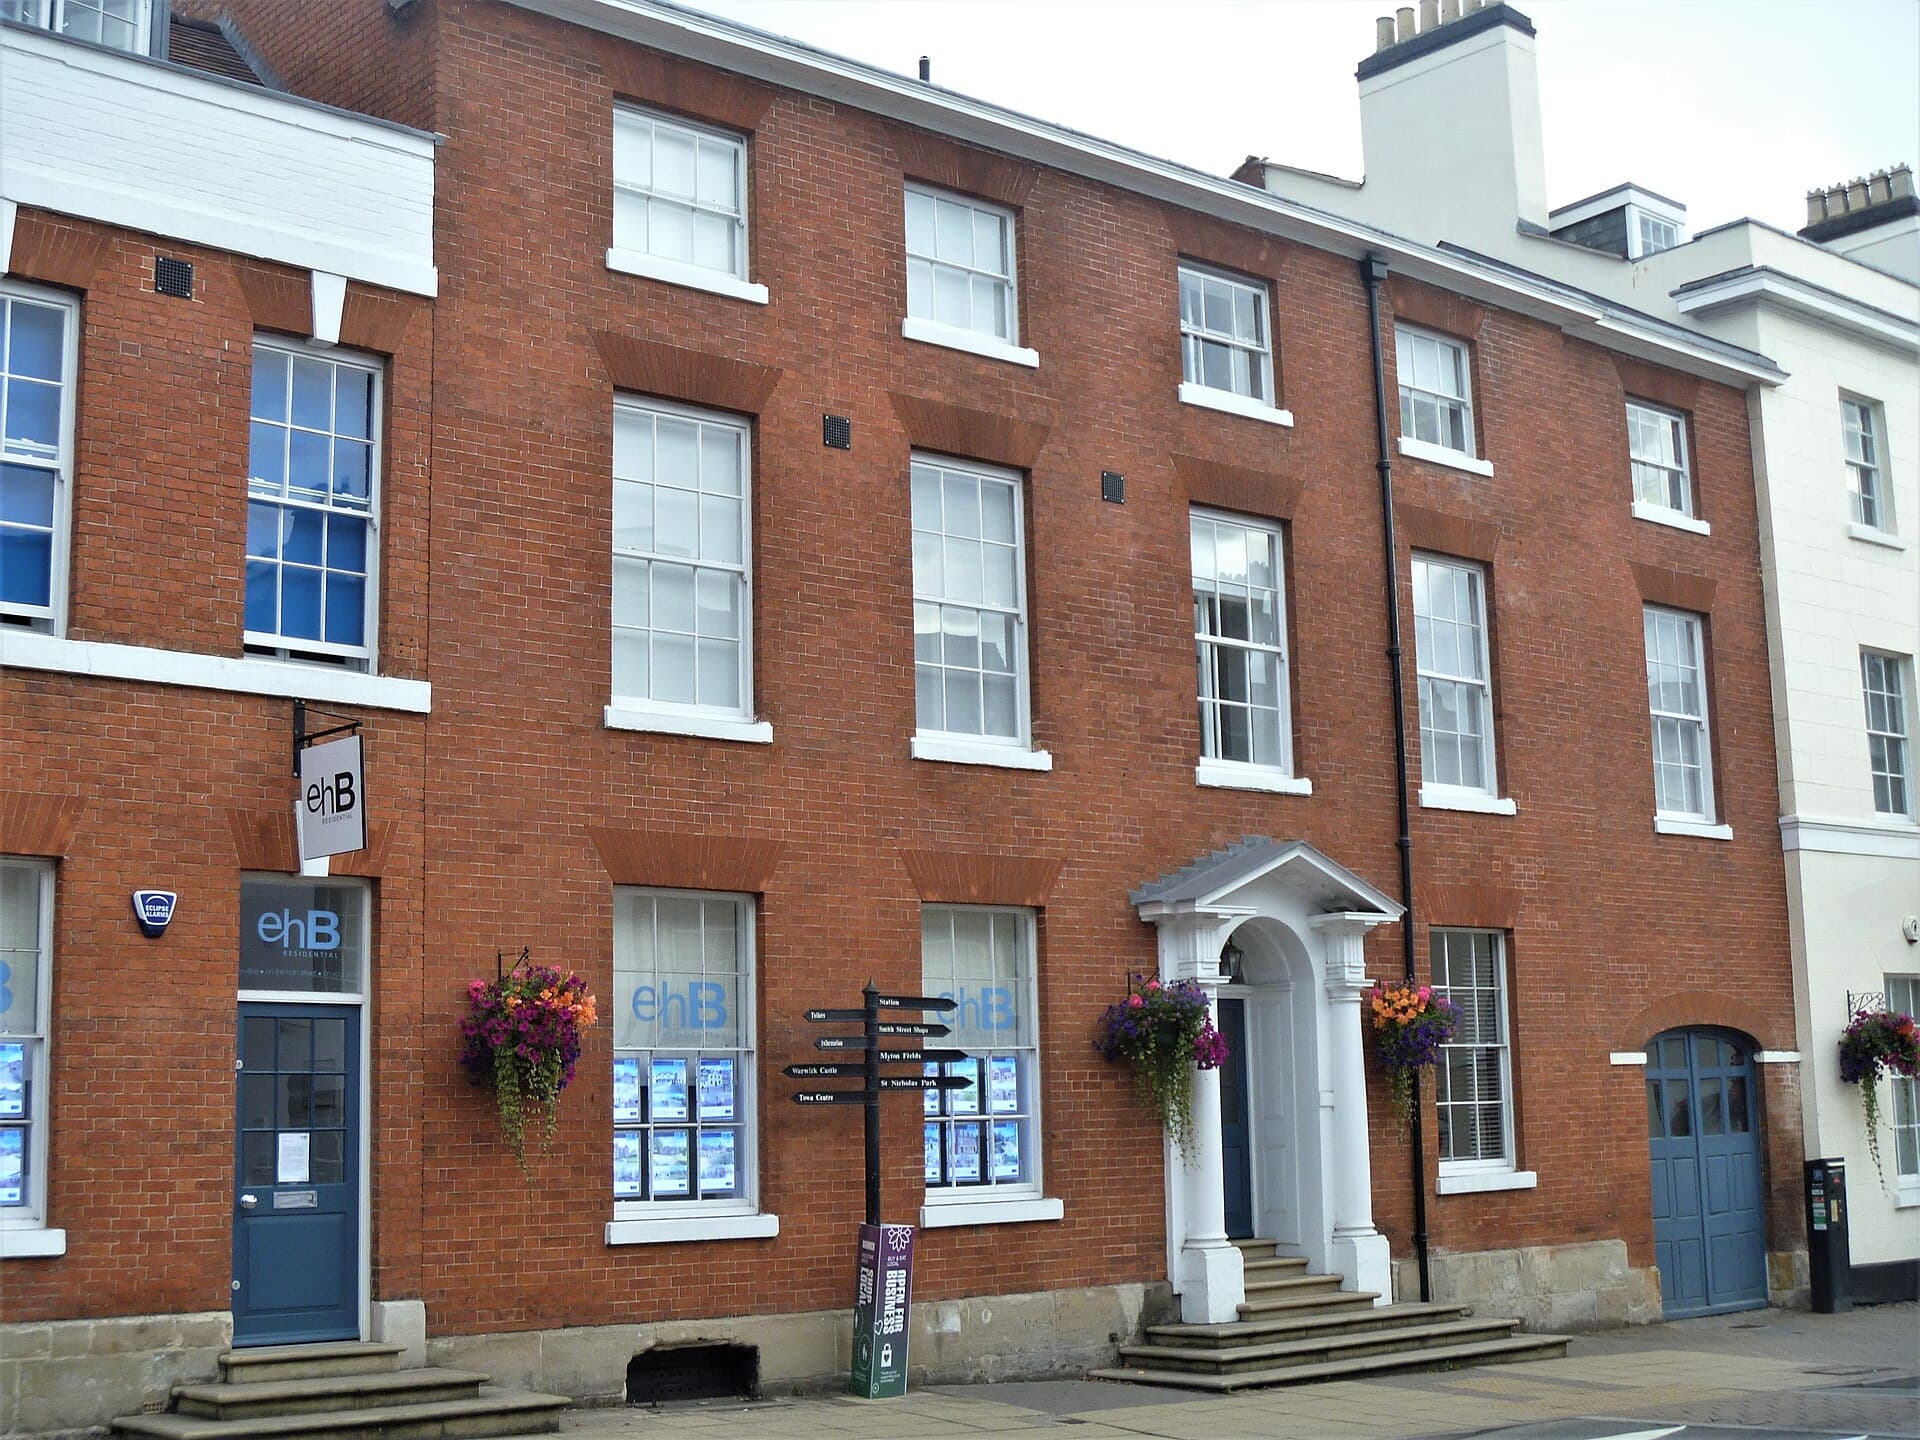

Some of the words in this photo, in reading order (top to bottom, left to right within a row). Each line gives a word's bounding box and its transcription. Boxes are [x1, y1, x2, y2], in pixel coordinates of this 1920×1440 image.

[306, 771, 356, 816] ehB
[257, 907, 341, 950] ehB
[283, 950, 339, 959] RESIDENTIAL
[631, 980, 728, 1030] ehB
[879, 999, 900, 1007] Station
[896, 1026, 912, 1034] Street
[879, 1052, 900, 1061] Myton
[902, 1052, 922, 1060] Fields
[792, 1067, 818, 1075] Warwick
[819, 1066, 838, 1074] Castle
[921, 1080, 937, 1088] Park
[859, 1266, 869, 1306] LOCAL
[896, 1270, 907, 1304] OPEN
[883, 1270, 898, 1335] BUSINESS
[893, 1307, 905, 1333] FOR
